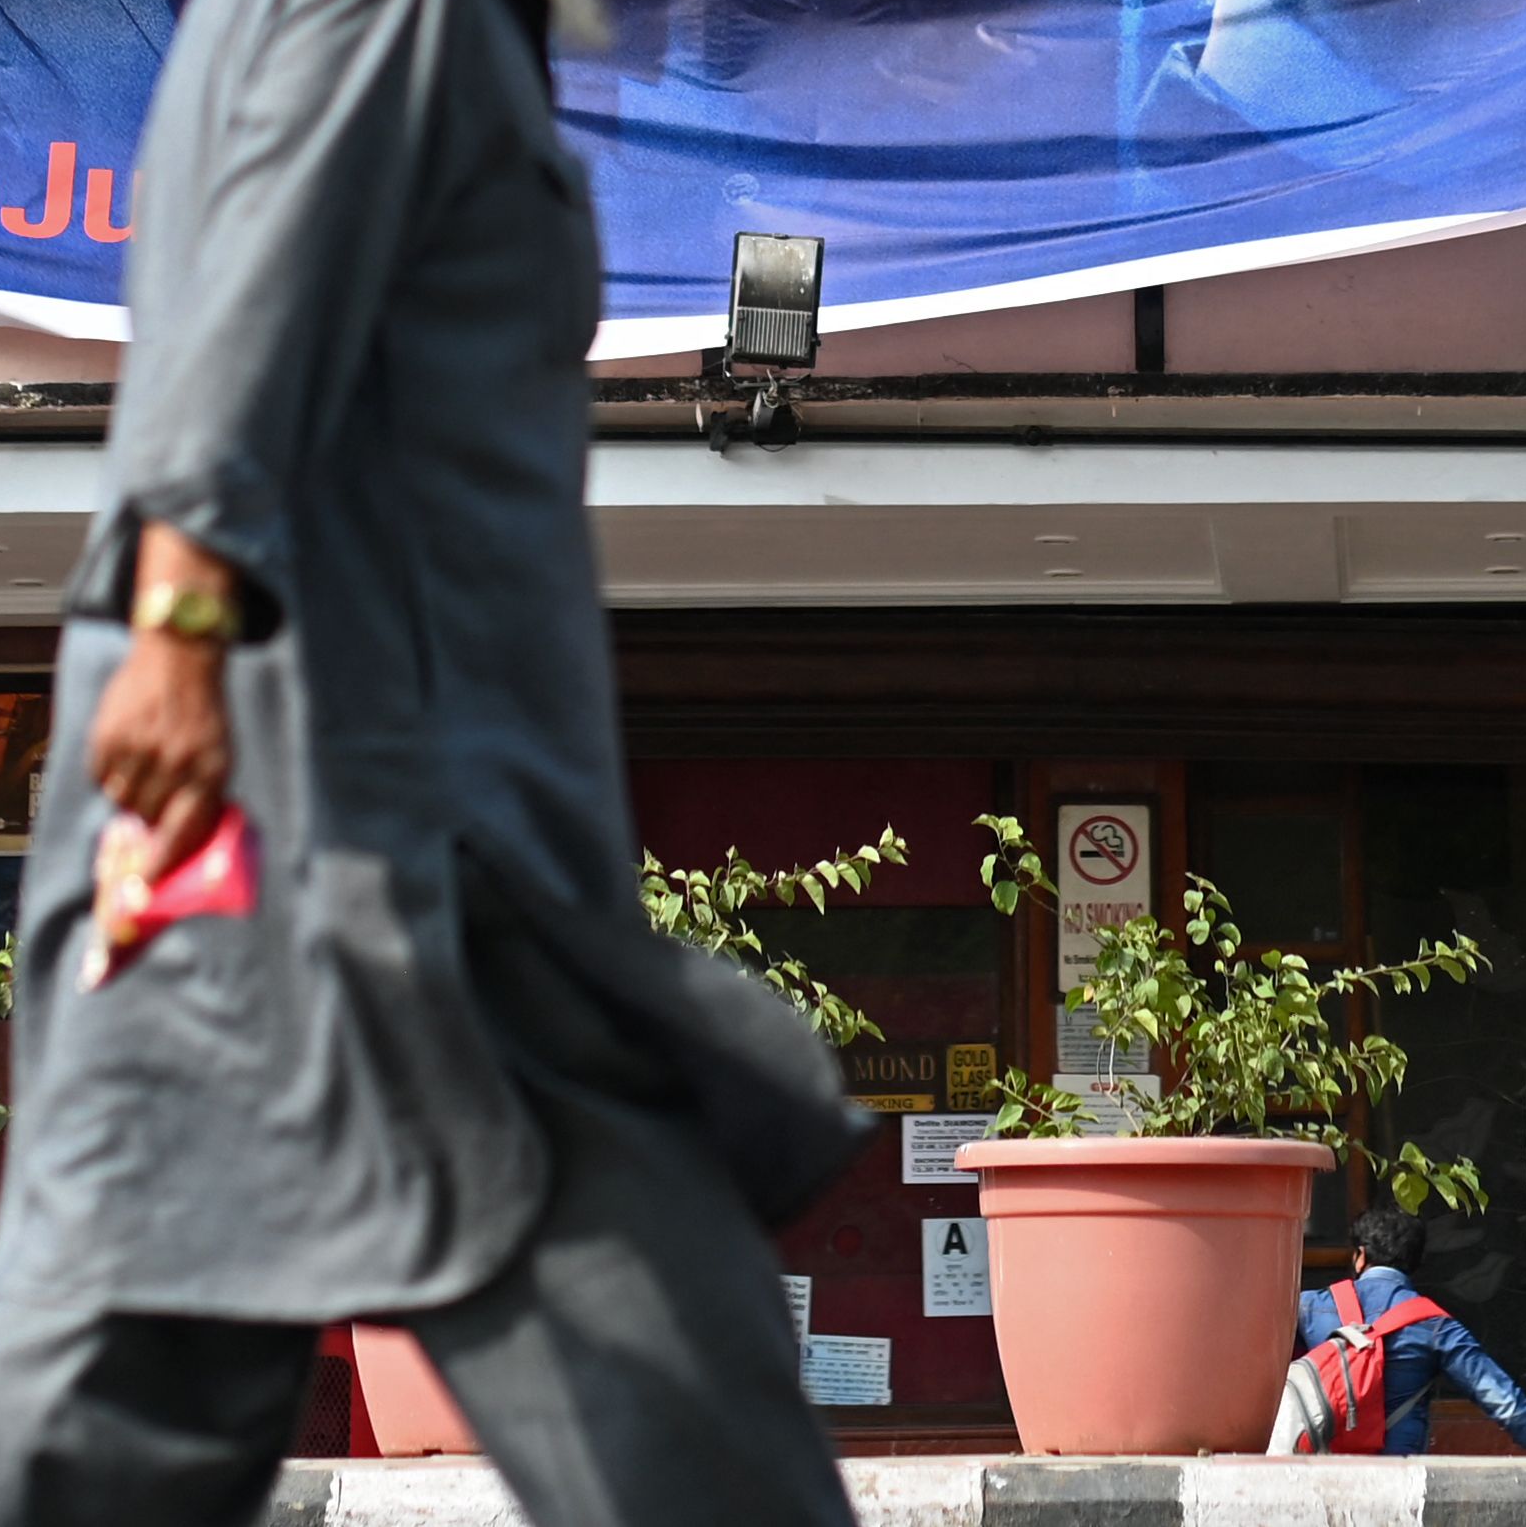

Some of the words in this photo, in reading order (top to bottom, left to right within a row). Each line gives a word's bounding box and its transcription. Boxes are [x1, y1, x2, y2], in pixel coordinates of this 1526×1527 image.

[853, 1055, 936, 1082] MOND
[954, 1050, 990, 1067] GOLD
[952, 1070, 993, 1088] CLASS
[942, 1222, 969, 1255] A
